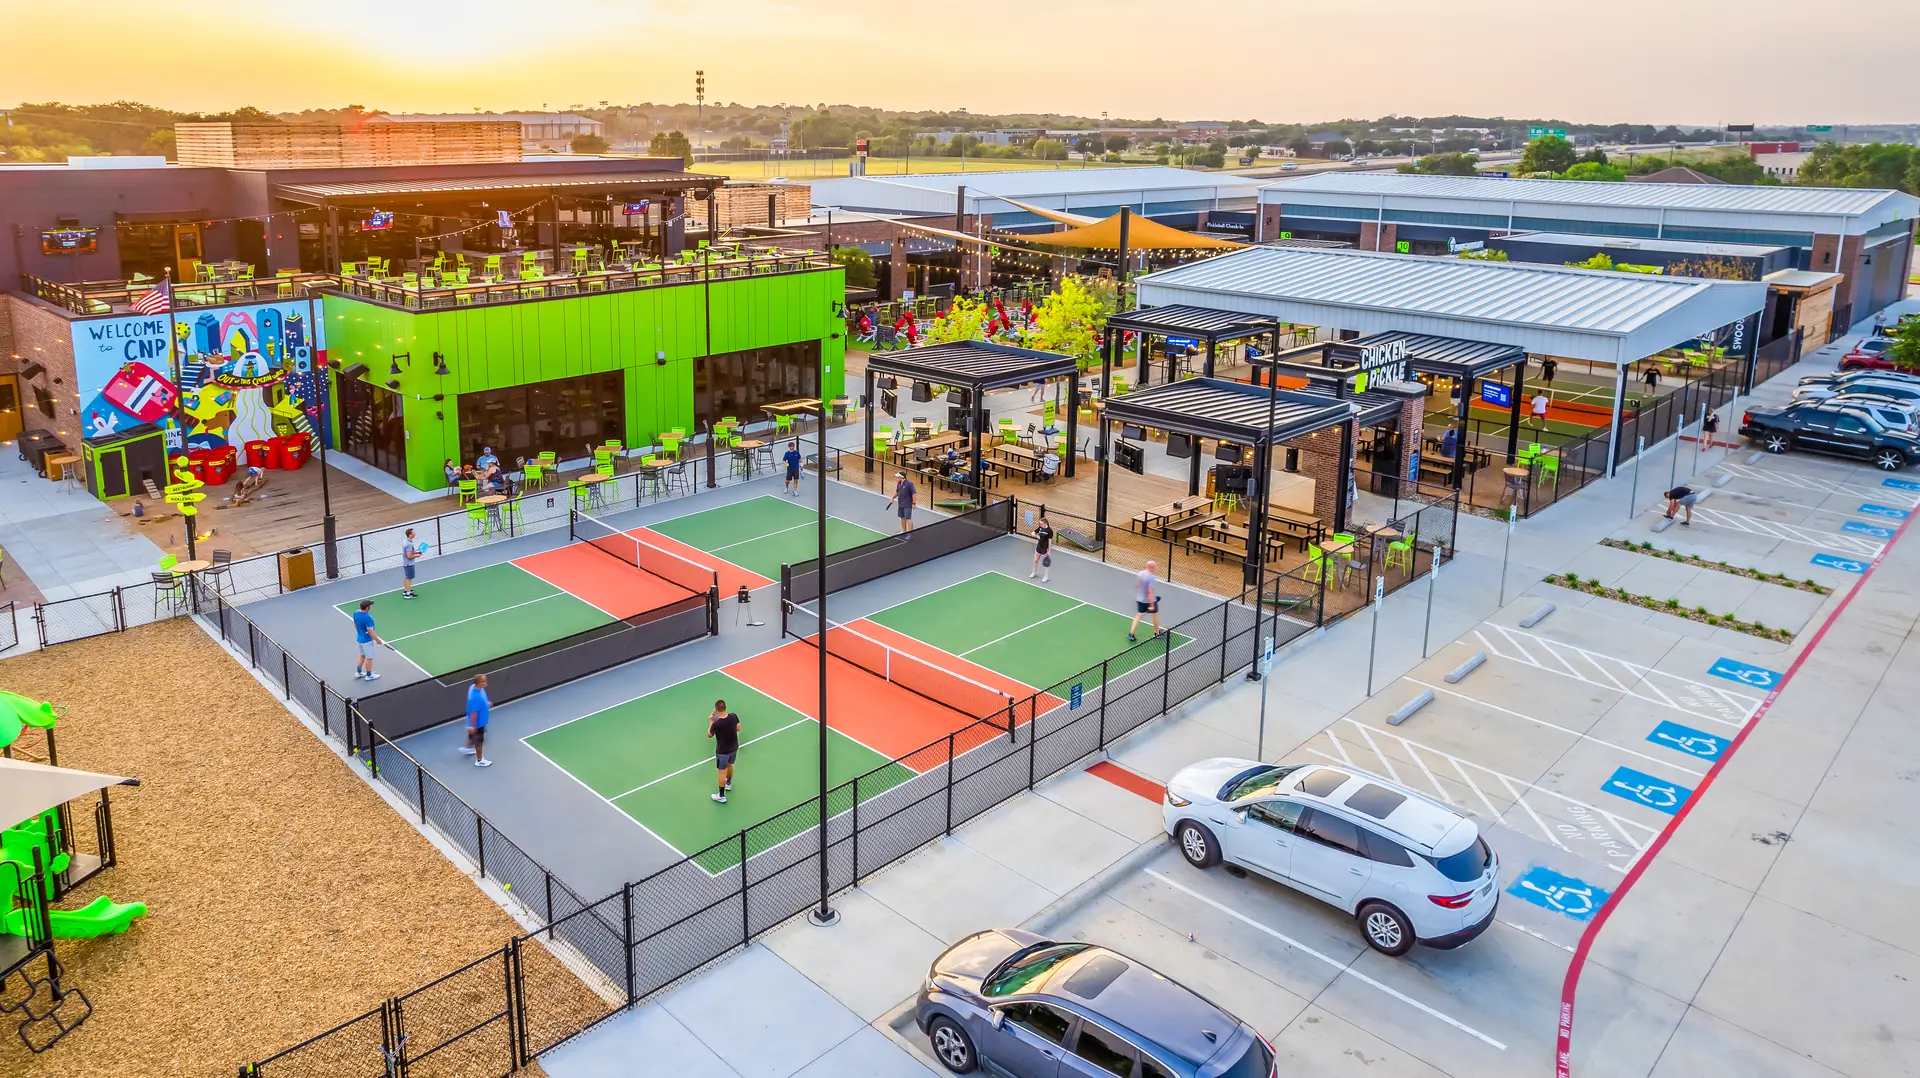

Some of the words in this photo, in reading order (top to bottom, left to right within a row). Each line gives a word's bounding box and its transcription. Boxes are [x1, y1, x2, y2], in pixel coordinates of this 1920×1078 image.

[1400, 242, 1408, 250] 10
[89, 321, 164, 339] WELCOME
[99, 344, 114, 352] to
[124, 339, 166, 361] CNP
[1361, 340, 1406, 370] CHICKEN
[218, 374, 235, 384] OUT
[166, 430, 182, 438] INK
[1684, 684, 1742, 720] PARKING
[1557, 824, 1586, 840] NO
[1566, 806, 1629, 857] PARKING
[1560, 1002, 1571, 1027] PARKING
[1560, 1028, 1570, 1038] NO
[1559, 1051, 1570, 1069] LANE
